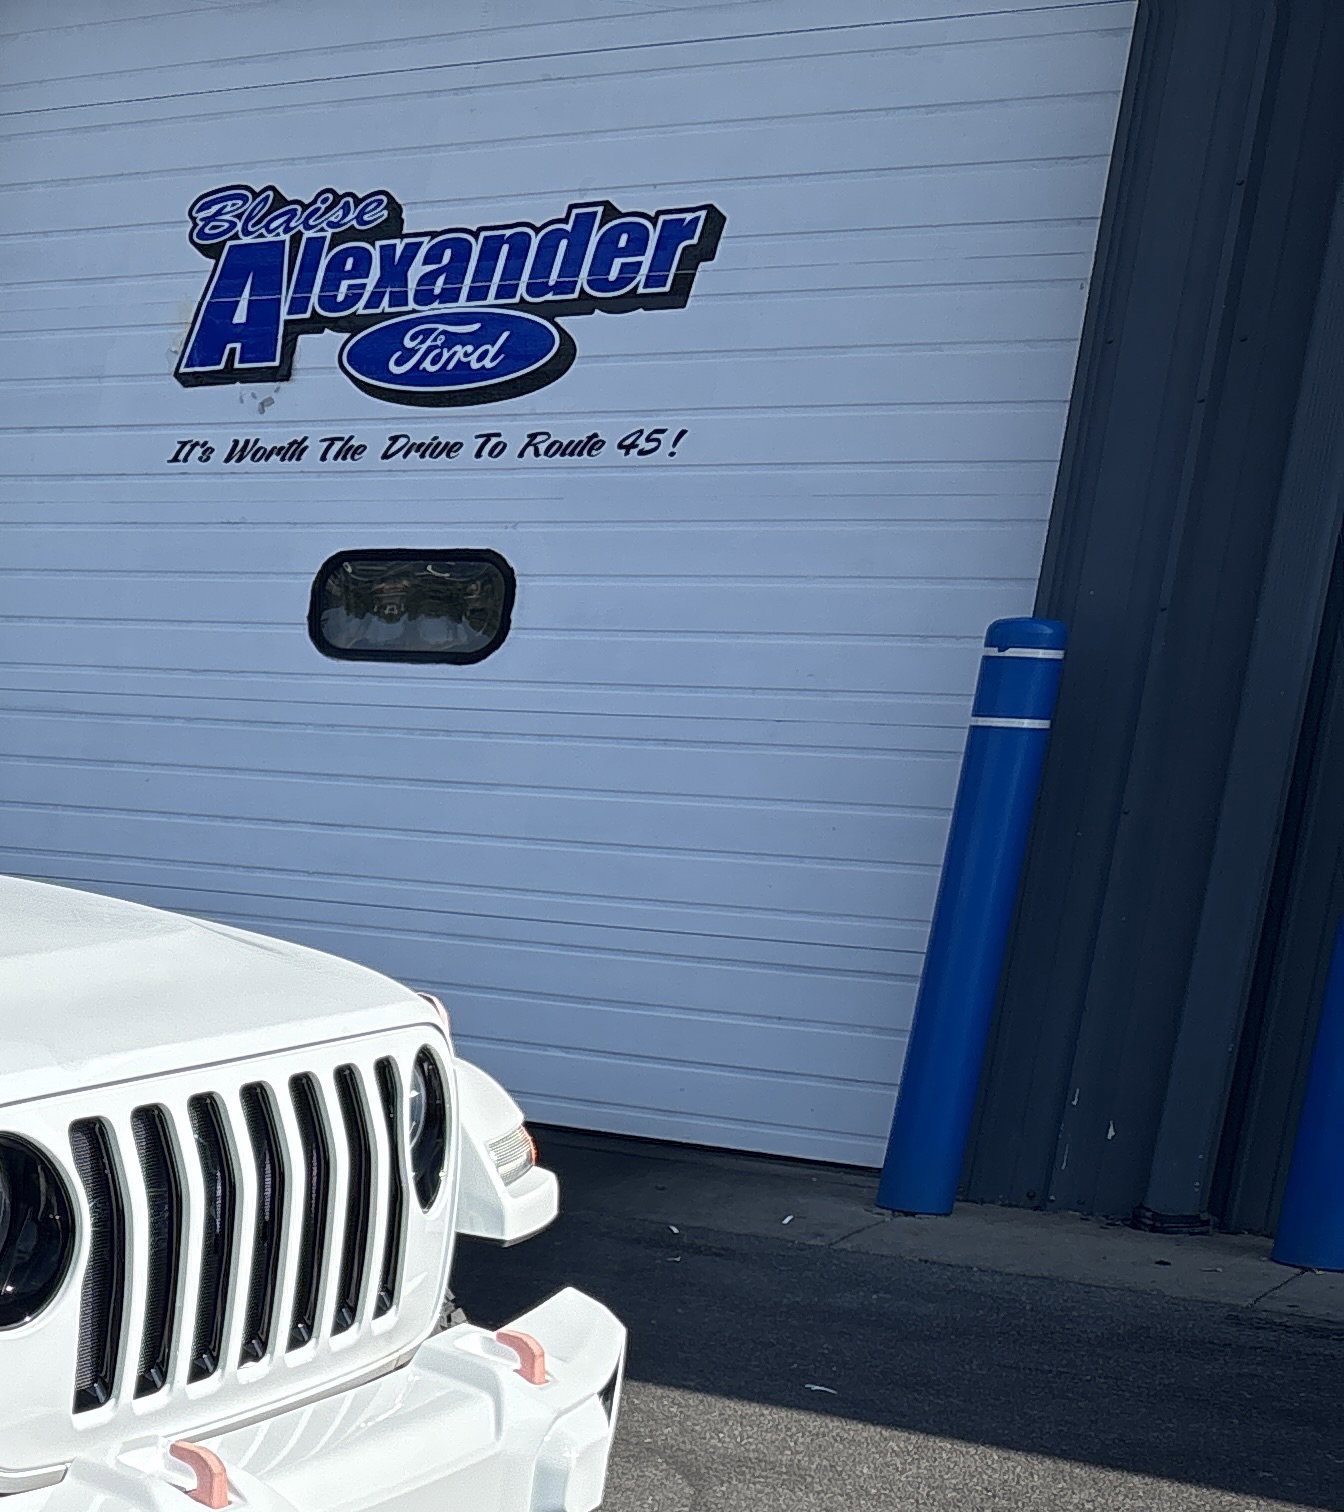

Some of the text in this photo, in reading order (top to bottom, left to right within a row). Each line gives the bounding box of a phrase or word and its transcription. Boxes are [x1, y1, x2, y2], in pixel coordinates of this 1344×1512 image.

[191, 189, 389, 244] Blaise
[177, 203, 710, 374] Alexander
[387, 321, 512, 376] Ford
[165, 427, 690, 465] It's Worth The Drive To Route 45!
